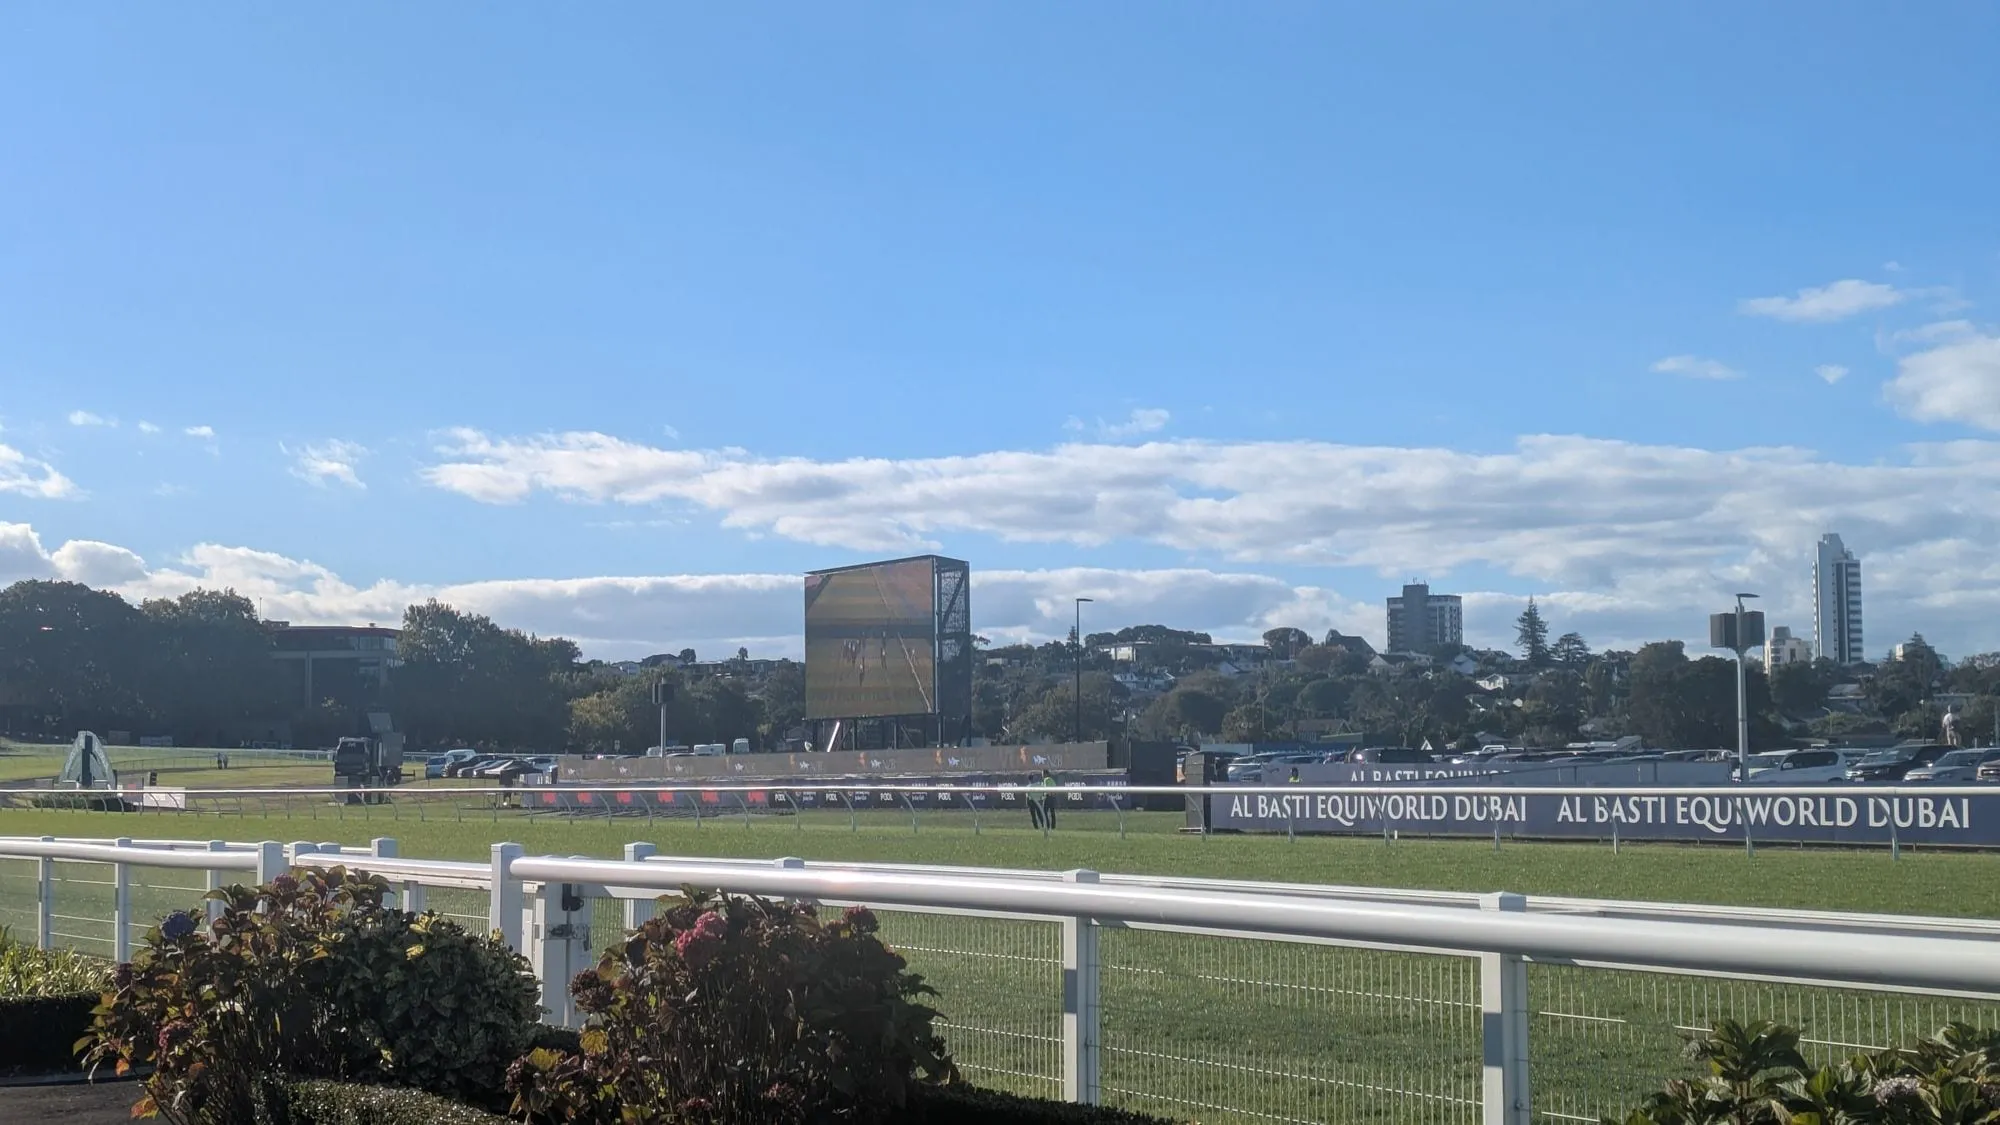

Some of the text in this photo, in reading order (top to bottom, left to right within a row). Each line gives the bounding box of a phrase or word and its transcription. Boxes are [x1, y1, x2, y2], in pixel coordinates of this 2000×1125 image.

[1231, 795, 1526, 826] AL BASTI EQUIWORLD DUBAI
[1557, 796, 1970, 833] AL BASTI EQUIWORLD DUBAI
